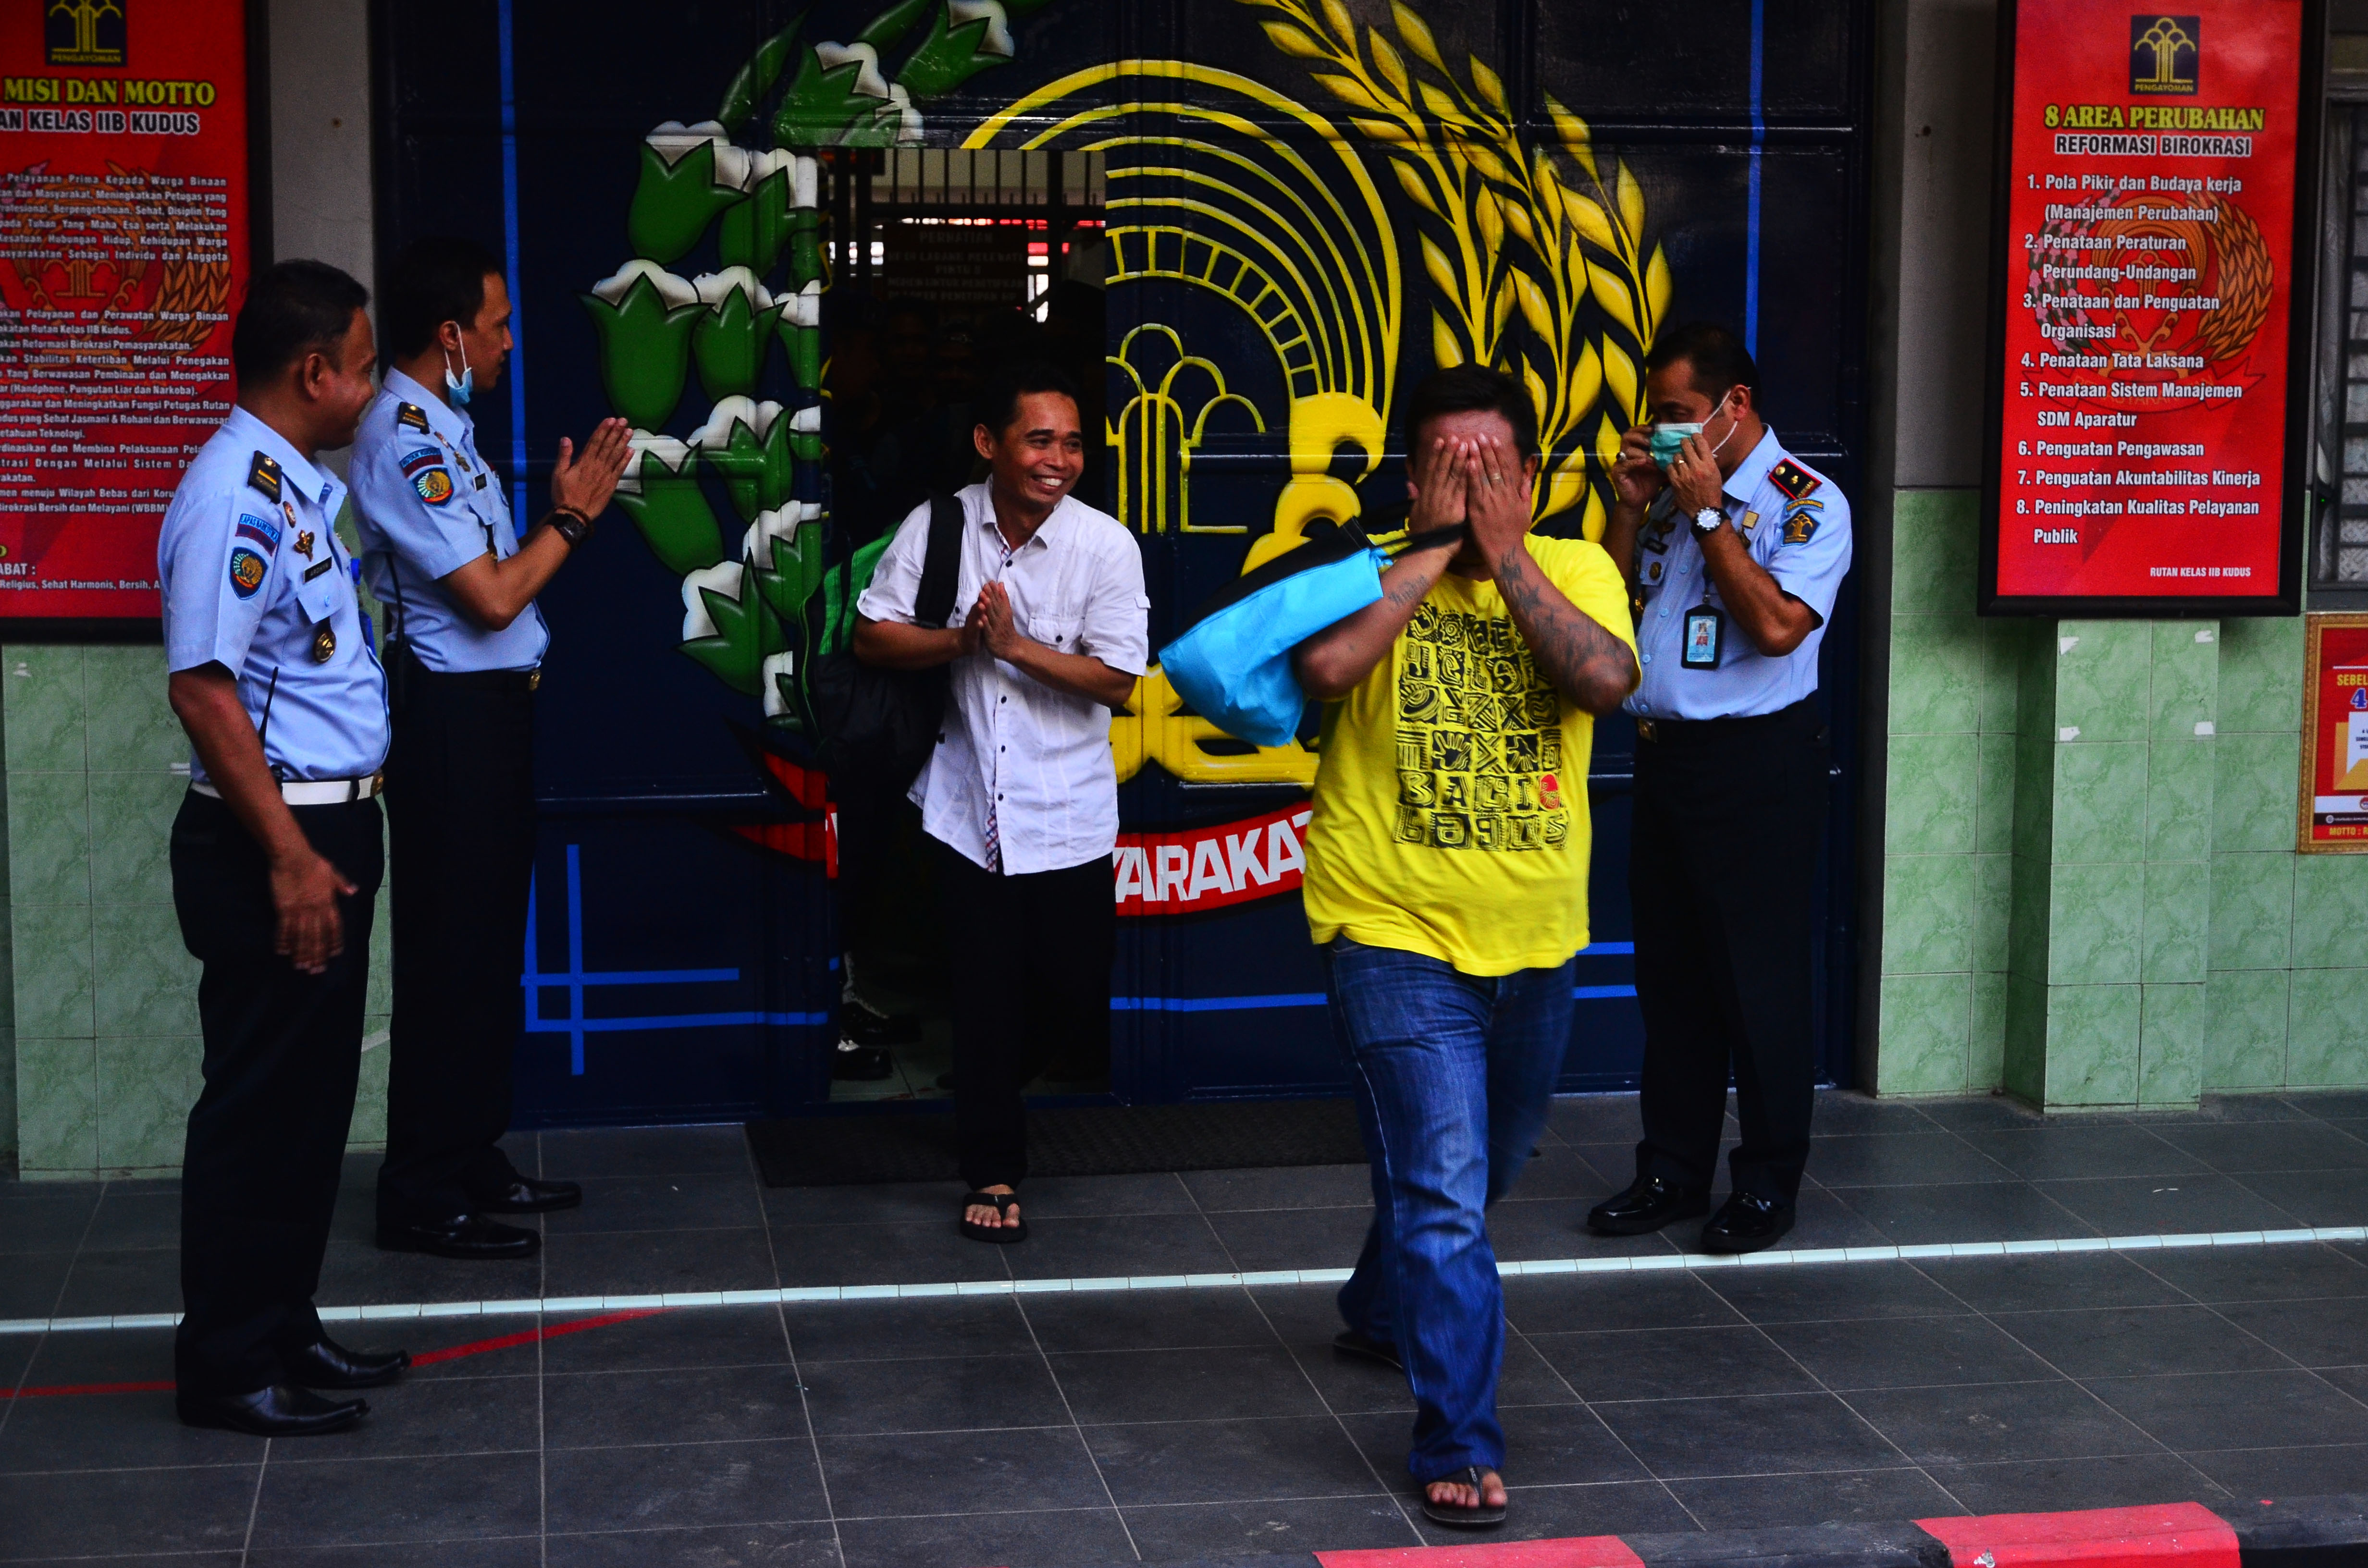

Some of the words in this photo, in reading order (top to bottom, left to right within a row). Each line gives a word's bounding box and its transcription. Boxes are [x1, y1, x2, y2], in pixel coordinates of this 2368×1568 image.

[4, 78, 60, 102] MISI
[66, 79, 117, 103] DAN
[124, 81, 215, 105] MOTTO
[2135, 84, 2193, 92] PENGAYOMAN
[28, 110, 91, 133] KELAS
[96, 111, 125, 133] IIB
[130, 111, 199, 135] KUDUS
[2045, 105, 2060, 127] 8
[2062, 106, 2124, 128] AREA
[2130, 108, 2264, 131] PERUBAHAN
[2055, 135, 2157, 155] REFORMASI
[2160, 136, 2252, 157] BIROKRASI
[68, 174, 99, 184] Prima
[106, 175, 144, 185] Kepada
[151, 176, 183, 187] Warga
[190, 177, 226, 186] Binaan
[2028, 175, 2040, 189] 1.
[2046, 175, 2076, 189] Pola
[2082, 175, 2114, 190] Pikir
[2120, 176, 2145, 190] dan
[2150, 176, 2202, 192] Budaya
[2207, 177, 2241, 192] kerja
[164, 192, 202, 202] Petugas
[204, 194, 226, 203] yang
[168, 207, 202, 216] Disiplin
[205, 207, 226, 218] Yang
[2045, 205, 2133, 222] (Manajemen
[2138, 206, 2219, 222] Perubahan)
[28, 219, 56, 227] Tuhan
[62, 220, 85, 230] Yang
[91, 220, 117, 229] Maha
[123, 221, 139, 229] Esa
[176, 221, 227, 231] Melakukan
[140, 237, 190, 246] Kehidupan
[197, 237, 227, 247] Warga
[2025, 234, 2037, 248] 2.
[2044, 235, 2112, 249] Penataan
[2116, 236, 2186, 250] Peraturan
[68, 250, 109, 260] Sebagai
[115, 251, 155, 260] Individu
[186, 252, 227, 262] Anggota
[2043, 265, 2196, 282] Perundang-Undangan
[2023, 294, 2036, 308] 3.
[2042, 294, 2109, 309] Penataan
[2114, 295, 2140, 308] dan
[2144, 295, 2220, 312] Penguatan
[26, 309, 75, 319] Pelayanan
[81, 310, 98, 319] dan
[104, 310, 154, 320] Perawatan
[160, 311, 190, 321] Warga
[196, 312, 229, 320] Binaan
[31, 324, 58, 333] Rutan
[60, 325, 85, 333] Kelas
[86, 325, 99, 333] IIB
[2041, 323, 2116, 339] Organisasi
[23, 339, 68, 348] Reformasi
[71, 340, 111, 349] Birokrasi
[113, 340, 192, 351] Pemasyarakatan.
[76, 355, 127, 364] Ketertiban
[133, 355, 169, 365] Melalui
[176, 356, 229, 367] Penegakan
[2021, 354, 2034, 367] 4.
[2040, 354, 2107, 368] Penataan
[2112, 354, 2142, 367] Tata
[2146, 354, 2204, 368] Laksana
[7, 369, 29, 380] Yang
[32, 369, 90, 379] Berwawasan
[94, 370, 145, 380] Pembinaan
[149, 371, 166, 380] dan
[171, 371, 229, 381] Menegakkan
[70, 384, 113, 395] Pungutan
[115, 385, 132, 394] Liar
[134, 386, 151, 394] dan
[153, 386, 197, 395] Narkoba).
[2020, 383, 2033, 397] 5.
[2039, 383, 2106, 397] Penataan
[2111, 383, 2158, 397] Sistem
[2162, 383, 2242, 400] Manajemen
[45, 399, 62, 407] dan
[63, 399, 129, 410] Meningkatkan
[131, 400, 161, 410] Fungsi
[164, 401, 200, 410] Petugas
[203, 401, 230, 409] Rutan
[20, 415, 42, 425] yang
[43, 414, 69, 423] Sehat
[71, 414, 110, 423] Jasmani
[111, 415, 118, 423] &
[121, 415, 152, 424] Rohani
[154, 416, 171, 424] dan
[2037, 412, 2069, 426] SDM
[2074, 412, 2137, 429] Aparatur
[39, 429, 86, 440] Teknologi.
[50, 444, 68, 453] dan
[73, 444, 115, 453] Membina
[120, 444, 178, 453] Pelaksanaan
[2018, 442, 2032, 455] 6.
[2037, 441, 2112, 458] Penguatan
[2117, 442, 2204, 458] Pengawasan
[35, 458, 77, 469] Dengan
[84, 459, 126, 467] Melalui
[134, 460, 172, 468] Sistem
[2018, 470, 2031, 485] 7.
[2036, 471, 2111, 488] Penguatan
[2116, 471, 2208, 485] Akuntabilitas
[2212, 471, 2260, 487] Kinerja
[21, 489, 55, 498] menuju
[59, 489, 95, 498] Wilayah
[99, 489, 127, 497] Bebas
[131, 489, 149, 497] dari
[38, 503, 67, 512] Bersih
[69, 504, 86, 512] dan
[88, 504, 129, 514] Melayani
[2016, 501, 2030, 514] 8.
[2035, 500, 2122, 517] Peningkatan
[2127, 500, 2184, 514] Kualitas
[2189, 501, 2259, 517] Pelayanan
[2034, 529, 2078, 543] Publik
[2150, 568, 2178, 577] RUTAN
[2181, 568, 2206, 577] KELAS
[2209, 568, 2220, 577] IIB
[2222, 568, 2251, 577] KUDUS
[42, 580, 67, 589] Sehat
[71, 580, 116, 589] Harmonis,
[119, 581, 150, 590] Bersih,
[2351, 688, 2367, 709] 4
[2329, 827, 2356, 835] MOTTO
